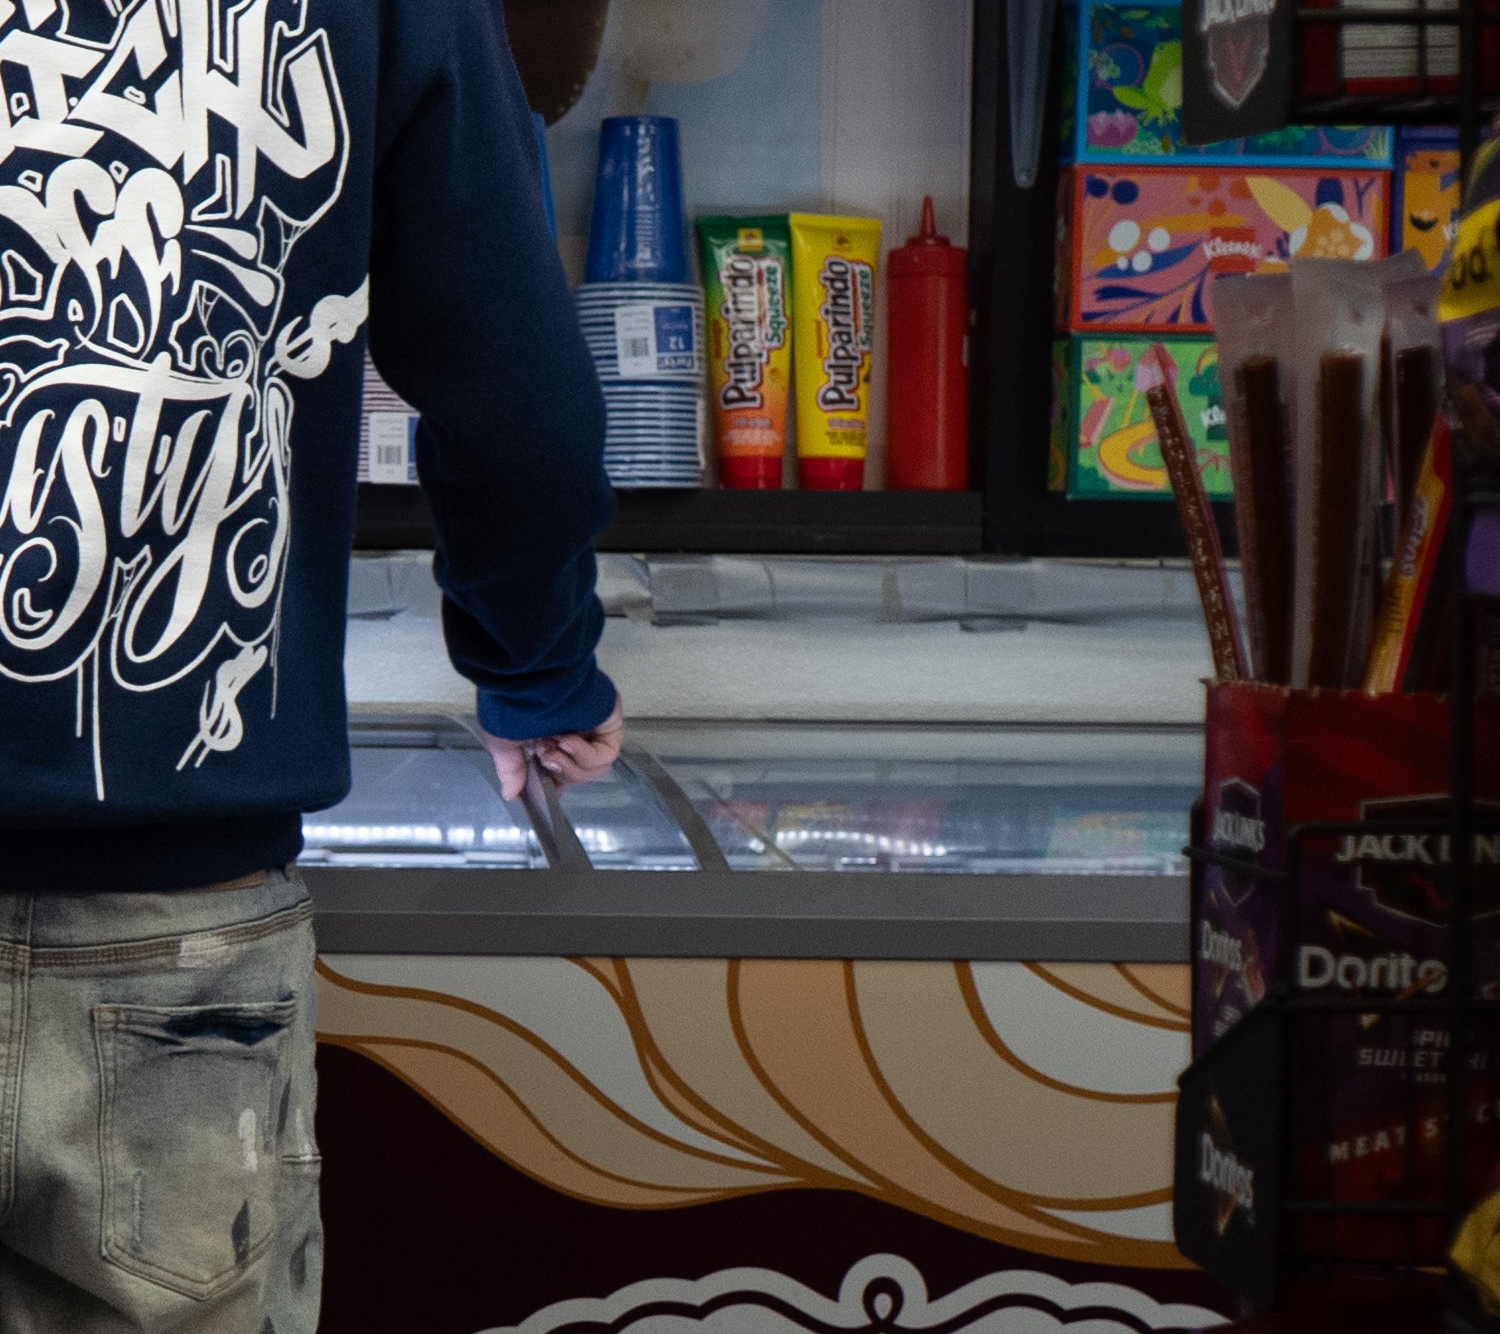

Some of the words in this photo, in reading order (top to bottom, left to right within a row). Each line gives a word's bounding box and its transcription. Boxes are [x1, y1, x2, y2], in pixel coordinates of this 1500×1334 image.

[722, 257, 762, 406] Pulparindo
[765, 266, 785, 344] Squeeze
[820, 259, 858, 405] Pulparindo
[1335, 835, 1434, 865] JACK
[1297, 945, 1448, 992] Dorito
[1330, 1127, 1408, 1164] MEAT
